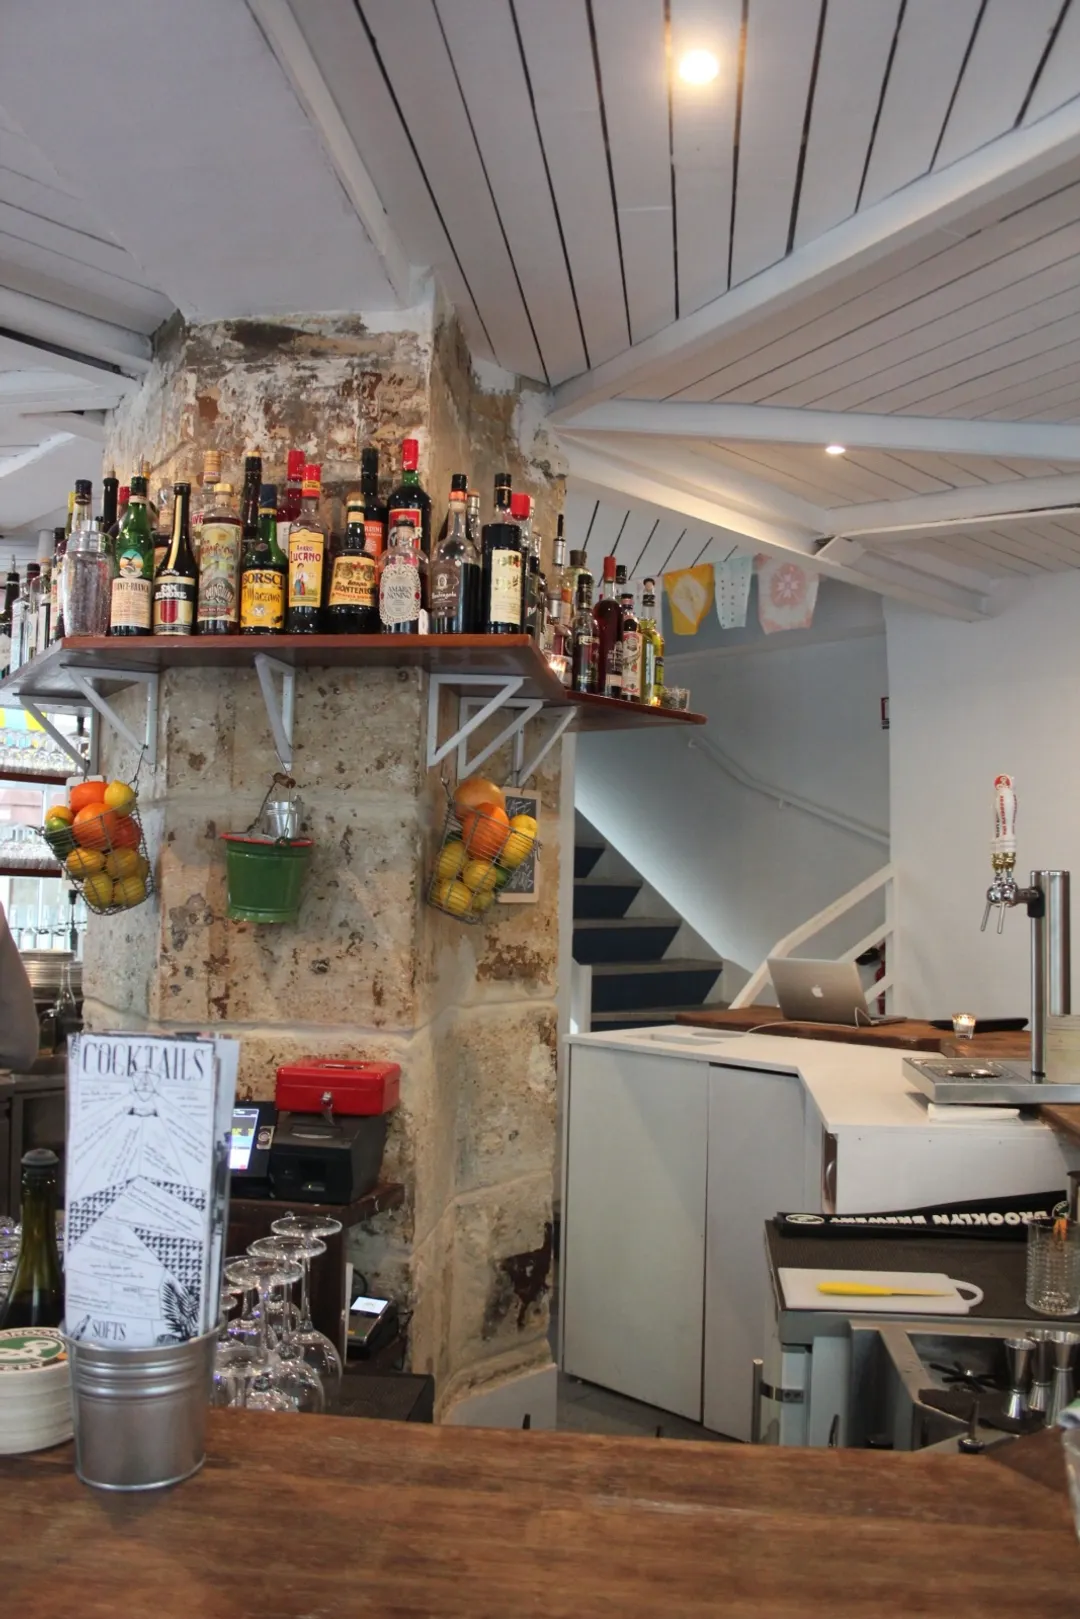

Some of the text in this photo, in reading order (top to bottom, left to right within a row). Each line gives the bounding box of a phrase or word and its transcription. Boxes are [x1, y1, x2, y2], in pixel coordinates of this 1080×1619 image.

[290, 551, 322, 563] LUCANO
[82, 1042, 205, 1081] COCKTAILS
[91, 1319, 127, 1341] SOFTS
